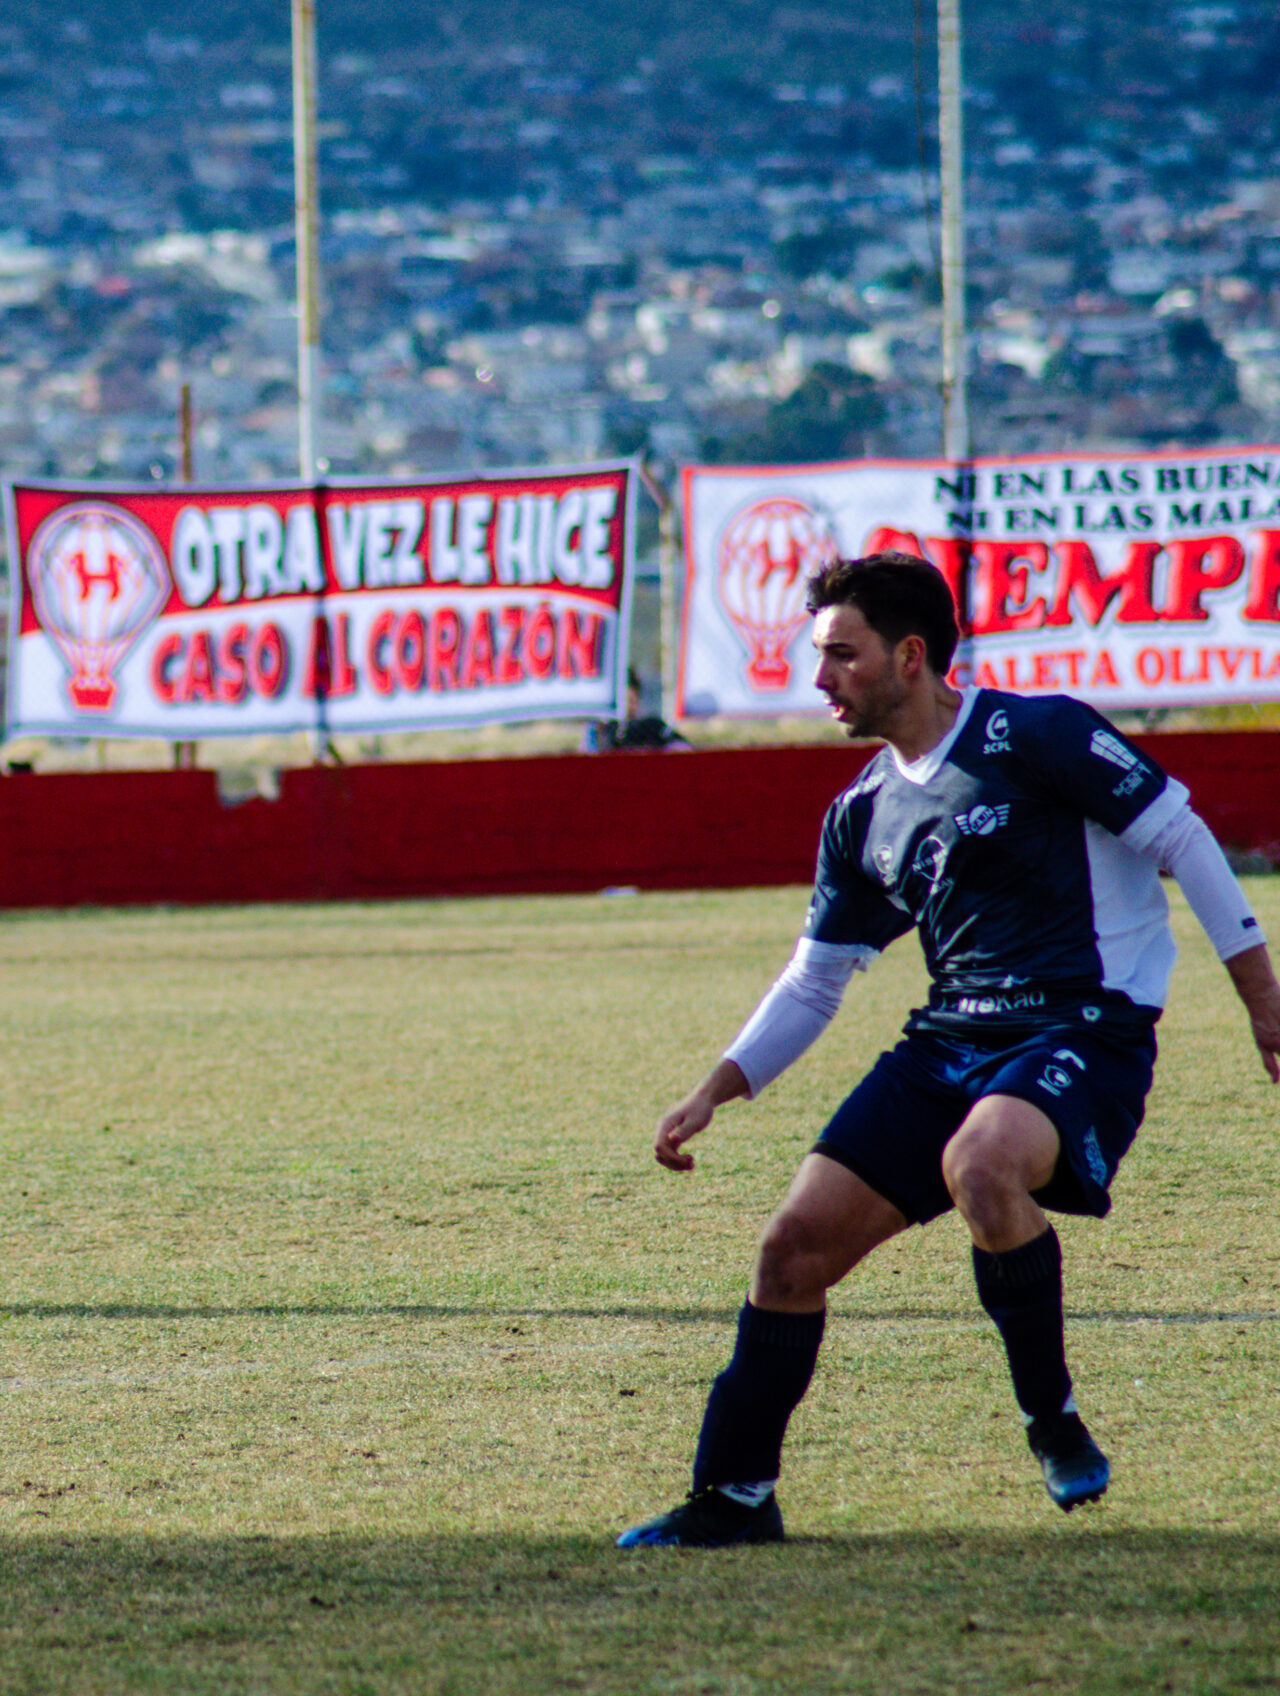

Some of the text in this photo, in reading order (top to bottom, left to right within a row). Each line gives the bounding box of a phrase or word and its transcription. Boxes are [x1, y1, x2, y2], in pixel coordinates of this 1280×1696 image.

[934, 461, 1280, 501] NI EN LAS BUEN
[947, 511, 988, 531] NI
[1005, 506, 1060, 530] EN
[1074, 503, 1154, 530] LAS
[171, 486, 619, 608] OTRA VEZ LE HICE
[862, 526, 1280, 637] IEMP
[150, 601, 604, 705] CASO AL CORAZÓN
[946, 650, 1123, 690] CALETA
[982, 740, 1013, 755] SCPL
